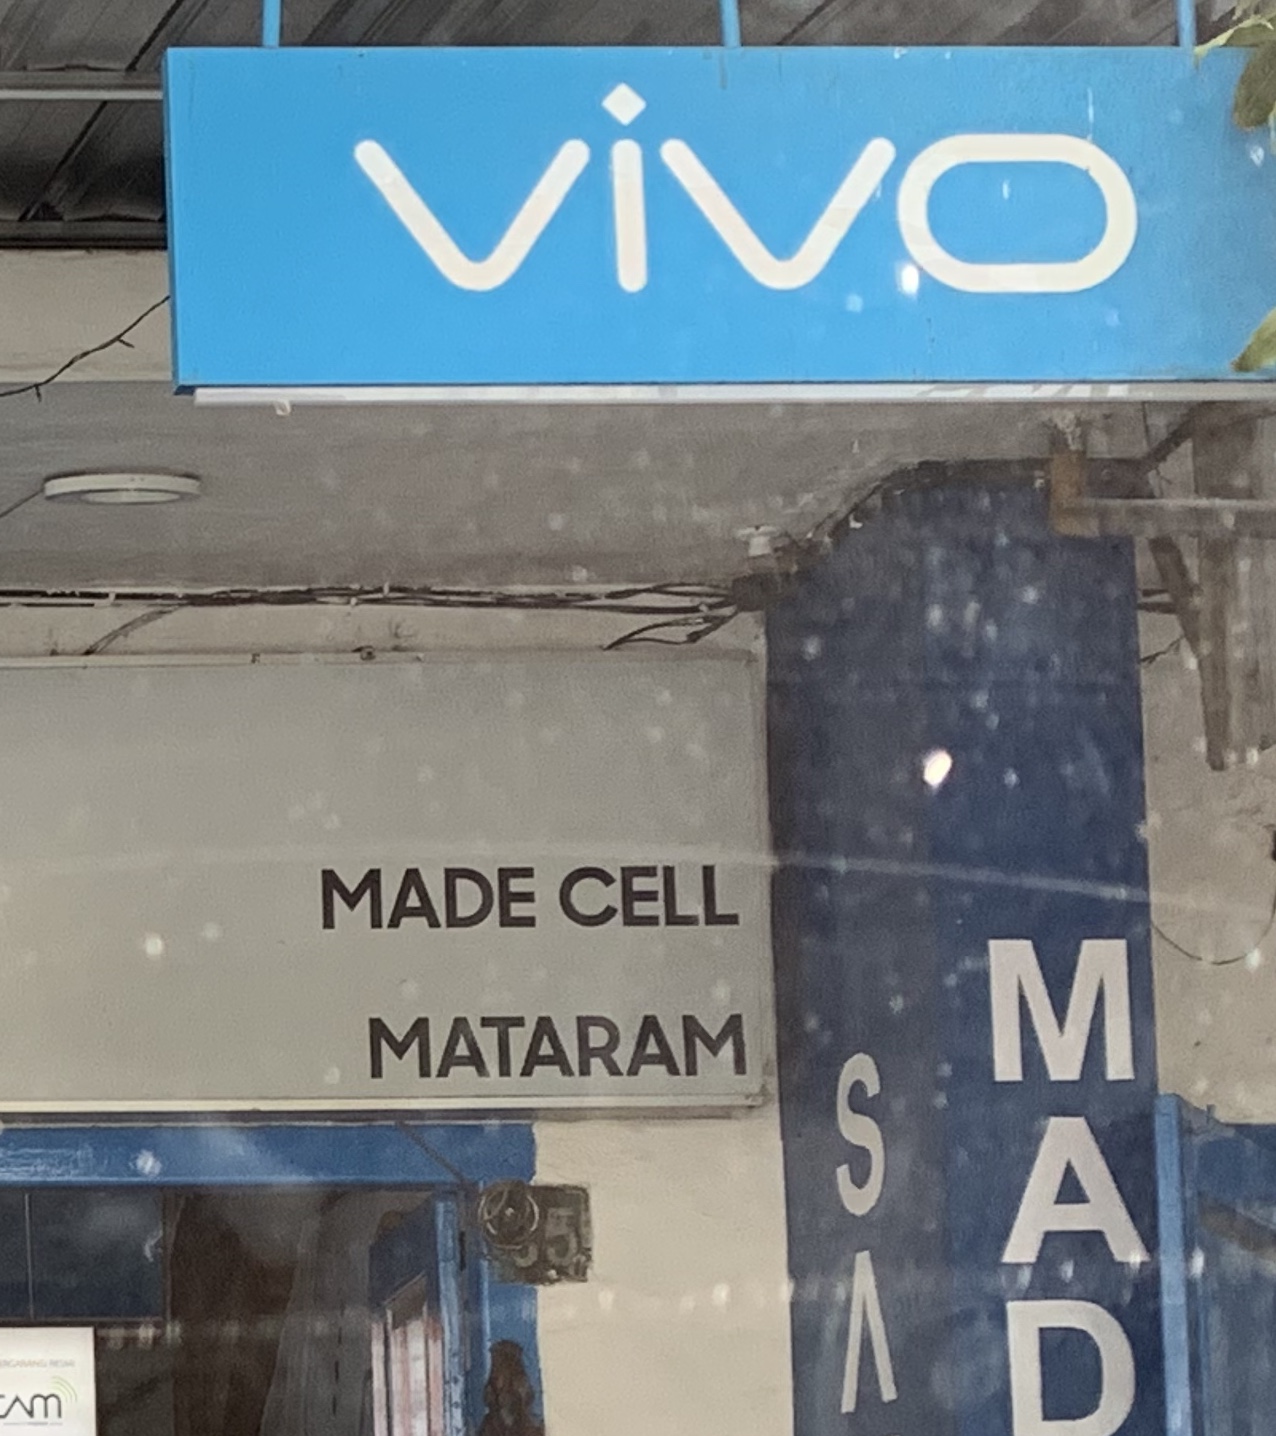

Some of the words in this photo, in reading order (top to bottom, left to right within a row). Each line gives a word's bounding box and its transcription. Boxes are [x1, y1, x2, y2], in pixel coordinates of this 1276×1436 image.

[353, 82, 1138, 293] vivo
[321, 866, 537, 929] MADE
[558, 864, 740, 927] CELL
[368, 1013, 747, 1079] MATARAM
